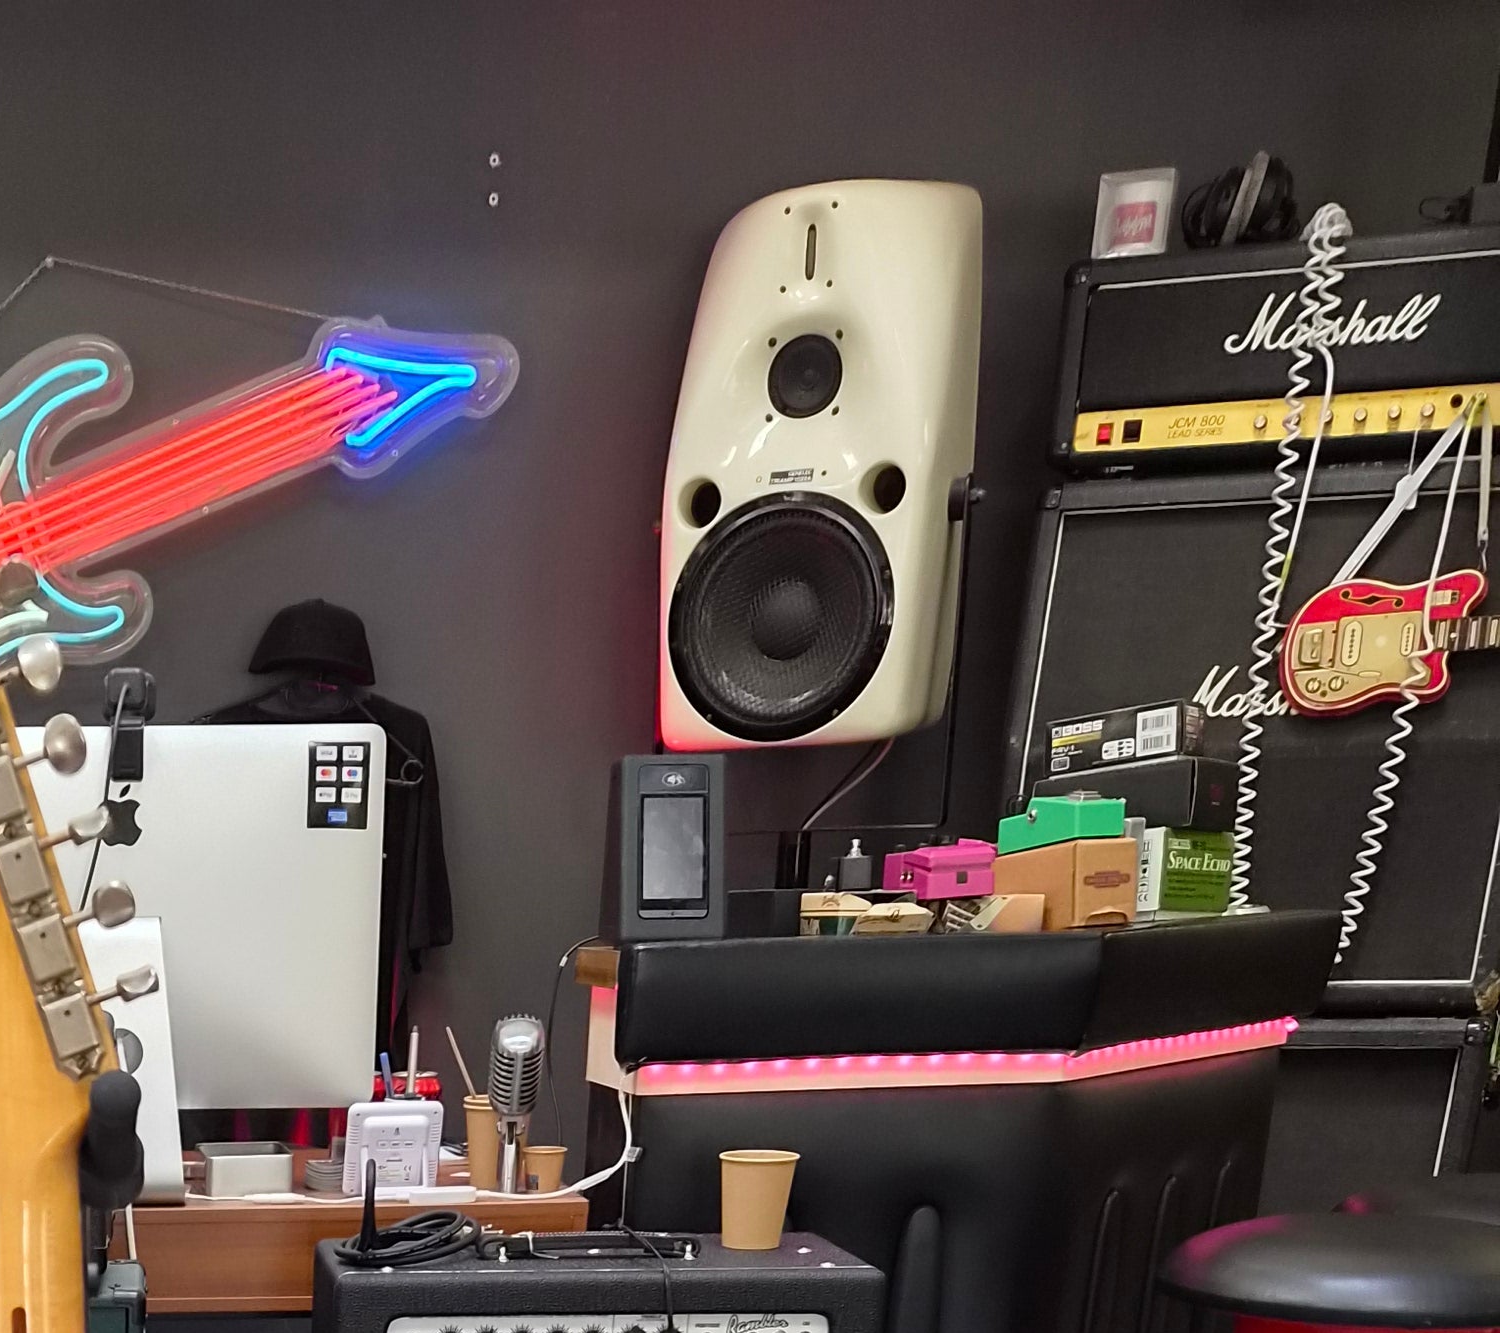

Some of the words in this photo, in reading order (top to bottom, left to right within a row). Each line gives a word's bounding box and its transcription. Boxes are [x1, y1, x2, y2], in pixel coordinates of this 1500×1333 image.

[1168, 416, 1196, 429] JCM
[1200, 414, 1226, 427] 800
[1167, 429, 1191, 439] LEAD
[1062, 720, 1104, 737] BOSS
[1167, 850, 1203, 871] SPACE
[1203, 853, 1232, 873] ECHO
